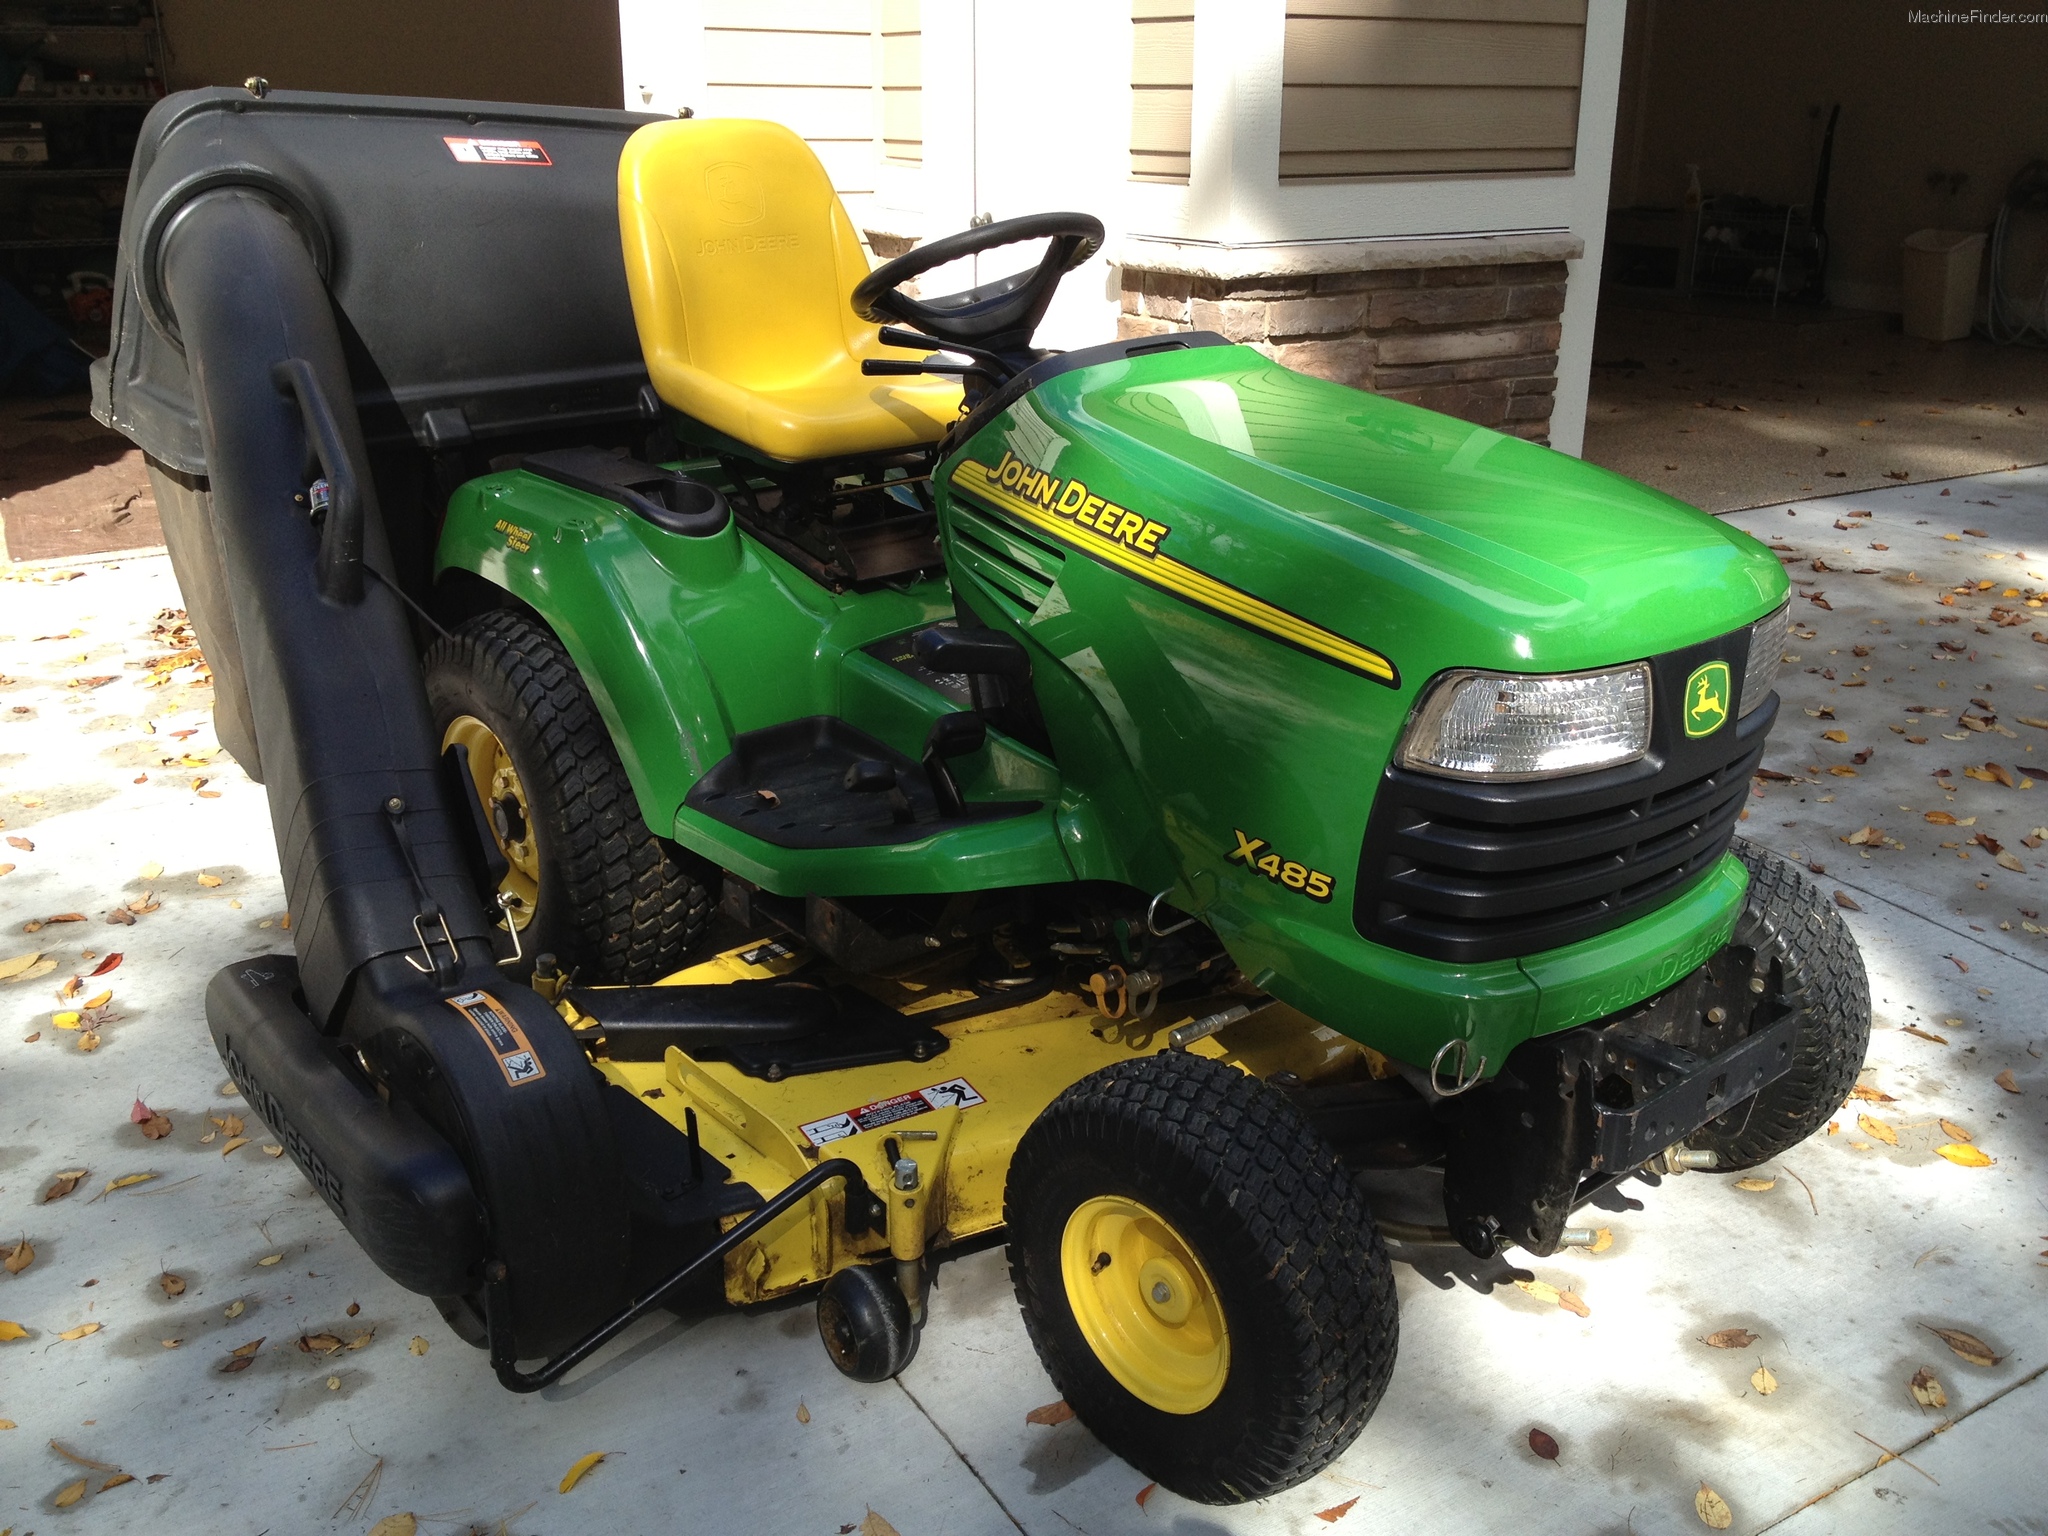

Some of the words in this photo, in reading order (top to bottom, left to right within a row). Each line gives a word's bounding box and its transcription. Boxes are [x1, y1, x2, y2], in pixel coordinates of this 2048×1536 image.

[697, 238, 740, 256] JOHN
[743, 234, 800, 253] DEERE
[986, 450, 1061, 508] JOHN
[1055, 479, 1169, 557] DEERE
[494, 519, 508, 532] All
[506, 522, 533, 543] Wheel
[506, 535, 531, 554] Steer
[1226, 828, 1334, 900] X485
[1557, 968, 1652, 1025] JOHN
[1656, 920, 1732, 988] DEERE
[222, 1034, 272, 1123] JOHN
[267, 1091, 347, 1217] DEERE
[869, 1094, 912, 1112] DNGER
